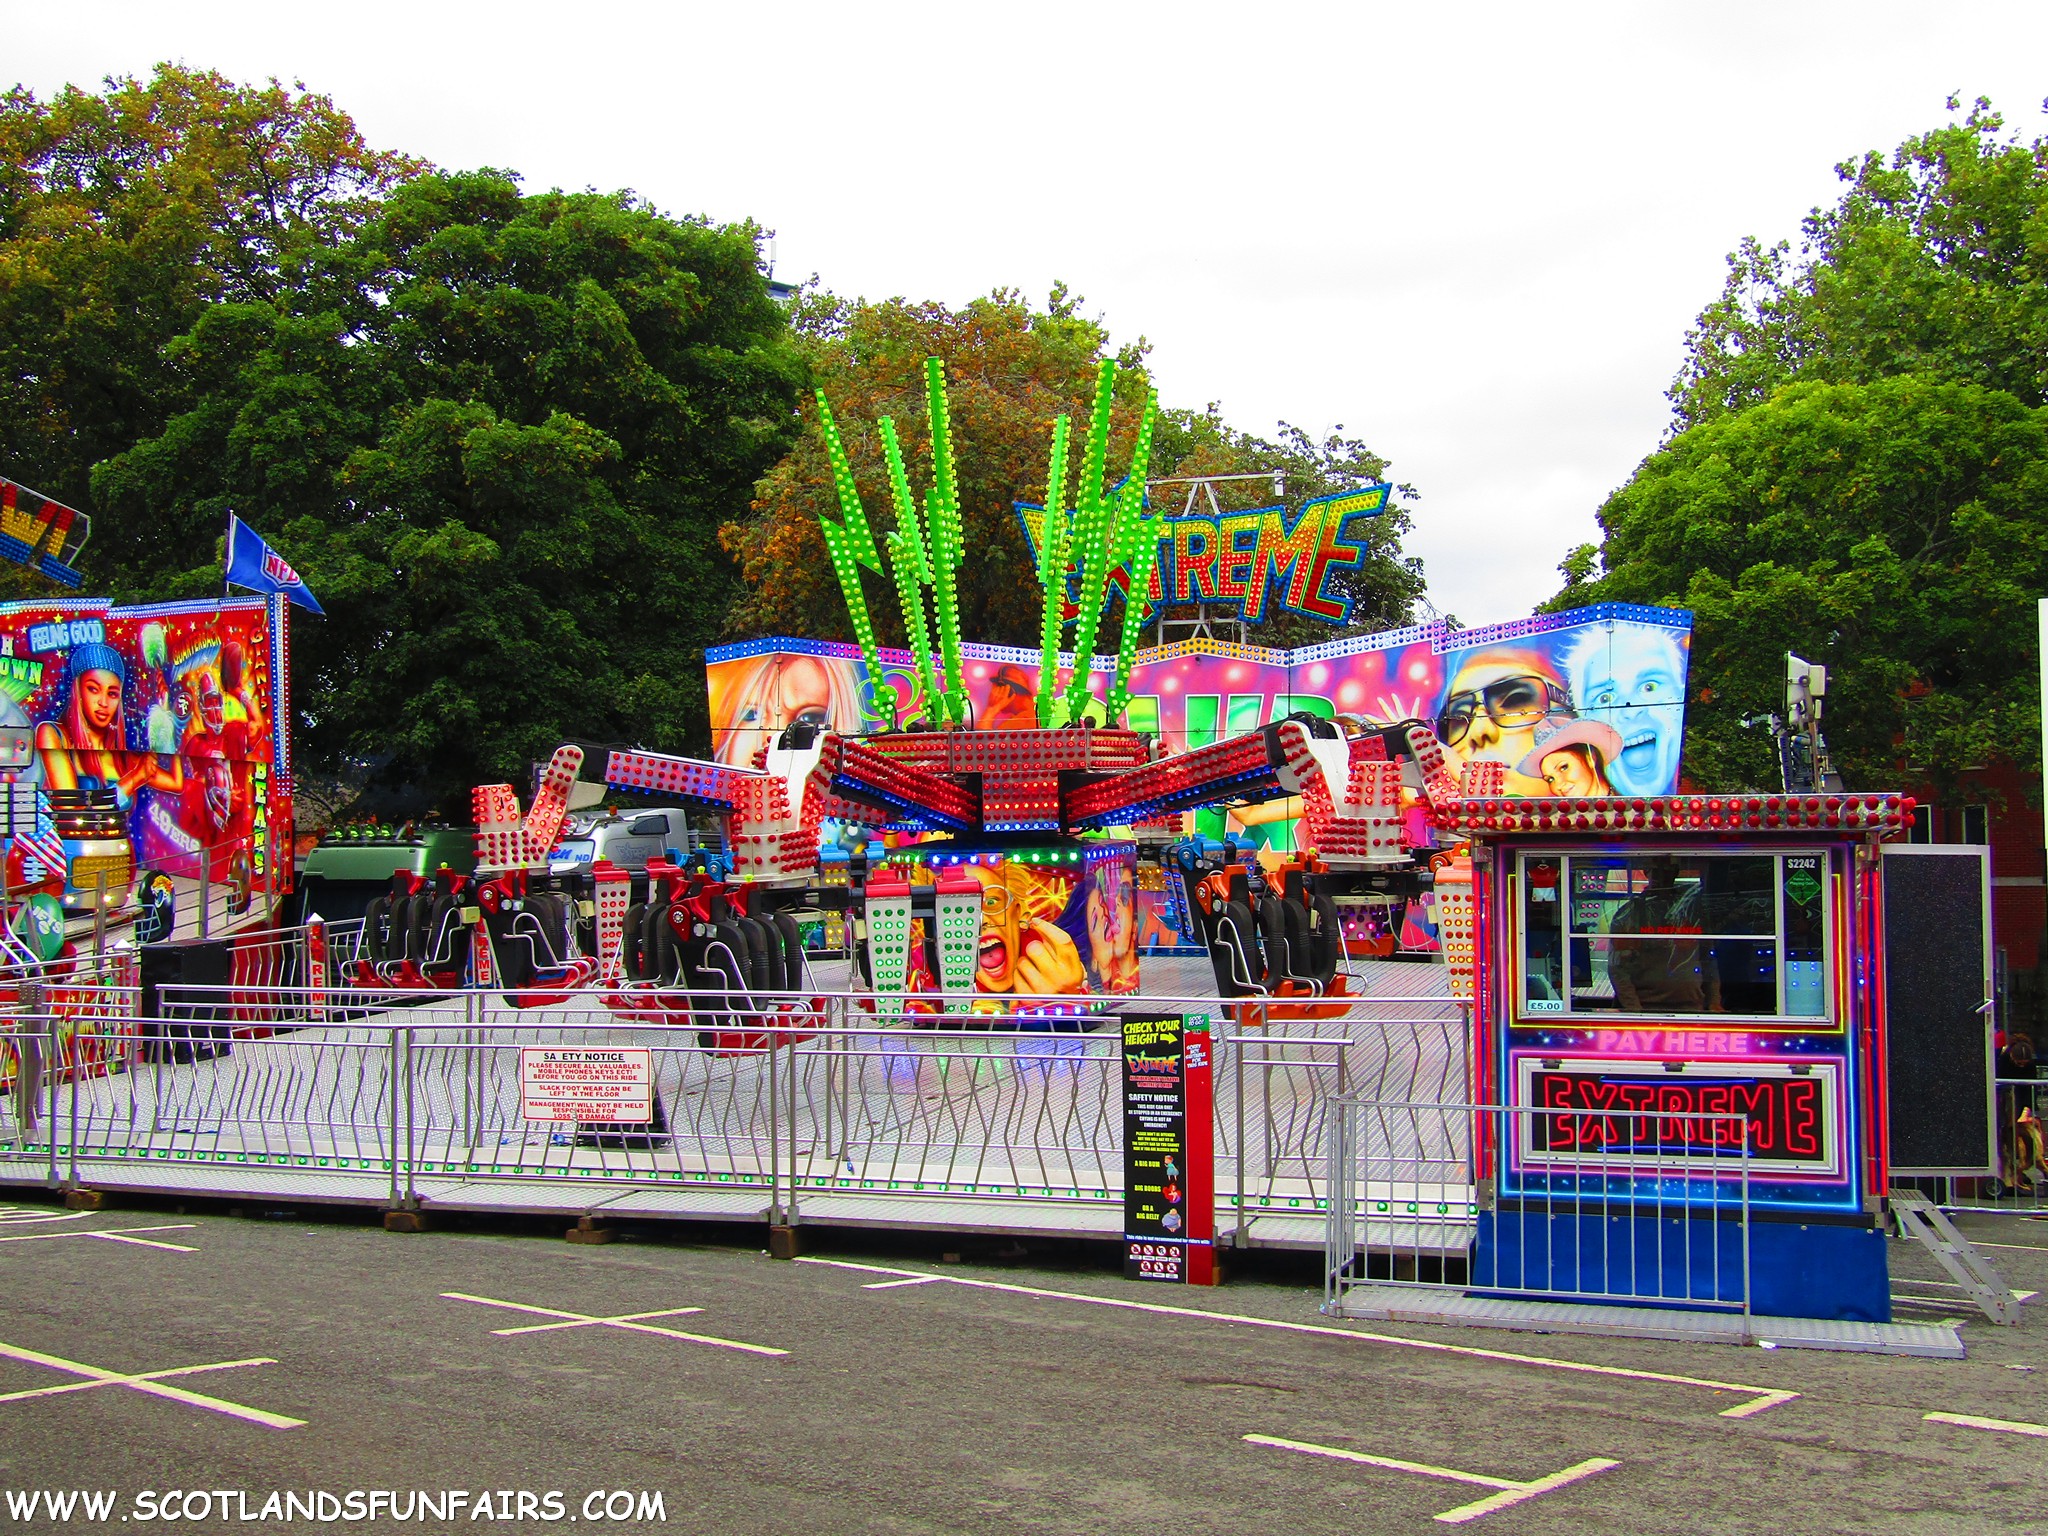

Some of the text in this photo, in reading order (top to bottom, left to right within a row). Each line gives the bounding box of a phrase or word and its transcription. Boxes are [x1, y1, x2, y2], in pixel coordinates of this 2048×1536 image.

[0, 480, 82, 589] WL
[1014, 481, 1392, 626] EREME
[266, 555, 299, 582] NFL
[31, 620, 103, 652] FEELING GOOD
[173, 630, 222, 666] QUARTERBACK
[249, 626, 269, 710] GIANTS
[253, 762, 268, 876] BEARS
[1787, 858, 1815, 868] S2242
[1640, 926, 1655, 934] NO
[1531, 1002, 1561, 1011] £5.00
[1124, 1022, 1153, 1034] CHECK
[1155, 1020, 1180, 1032] YOUR
[1125, 1033, 1158, 1045] HEIGHT
[1599, 1030, 1748, 1054] PAY HERE
[544, 1052, 581, 1060] SAETY
[1125, 1050, 1181, 1074] EXTREME
[1129, 1093, 1179, 1102] SAFETY NOTICE
[1544, 1076, 1816, 1154] EXTREME
[1148, 1160, 1161, 1168] BUM
[1144, 1185, 1161, 1193] BOOBS
